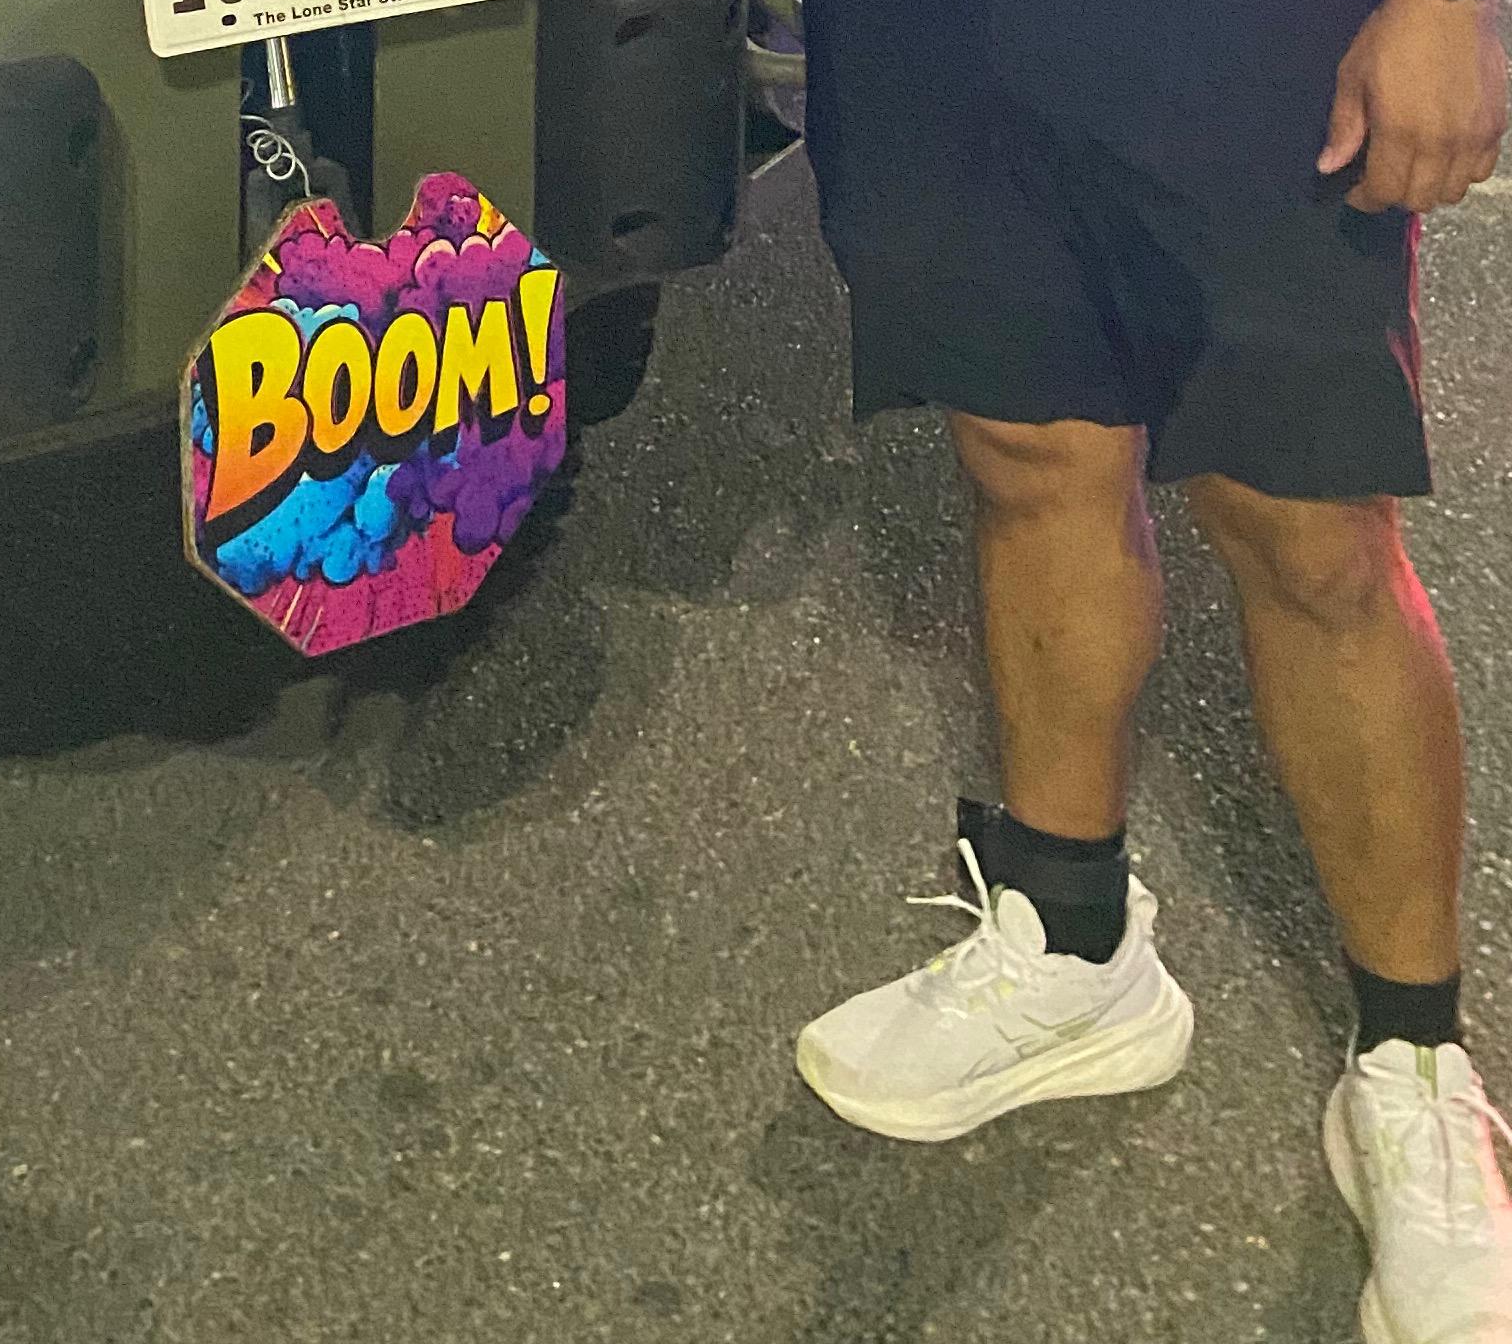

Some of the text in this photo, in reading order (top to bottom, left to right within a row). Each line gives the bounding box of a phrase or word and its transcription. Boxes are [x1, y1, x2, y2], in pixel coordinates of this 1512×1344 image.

[253, 10, 287, 27] The
[292, 1, 333, 20] Lone
[204, 267, 560, 524] BOOM!
